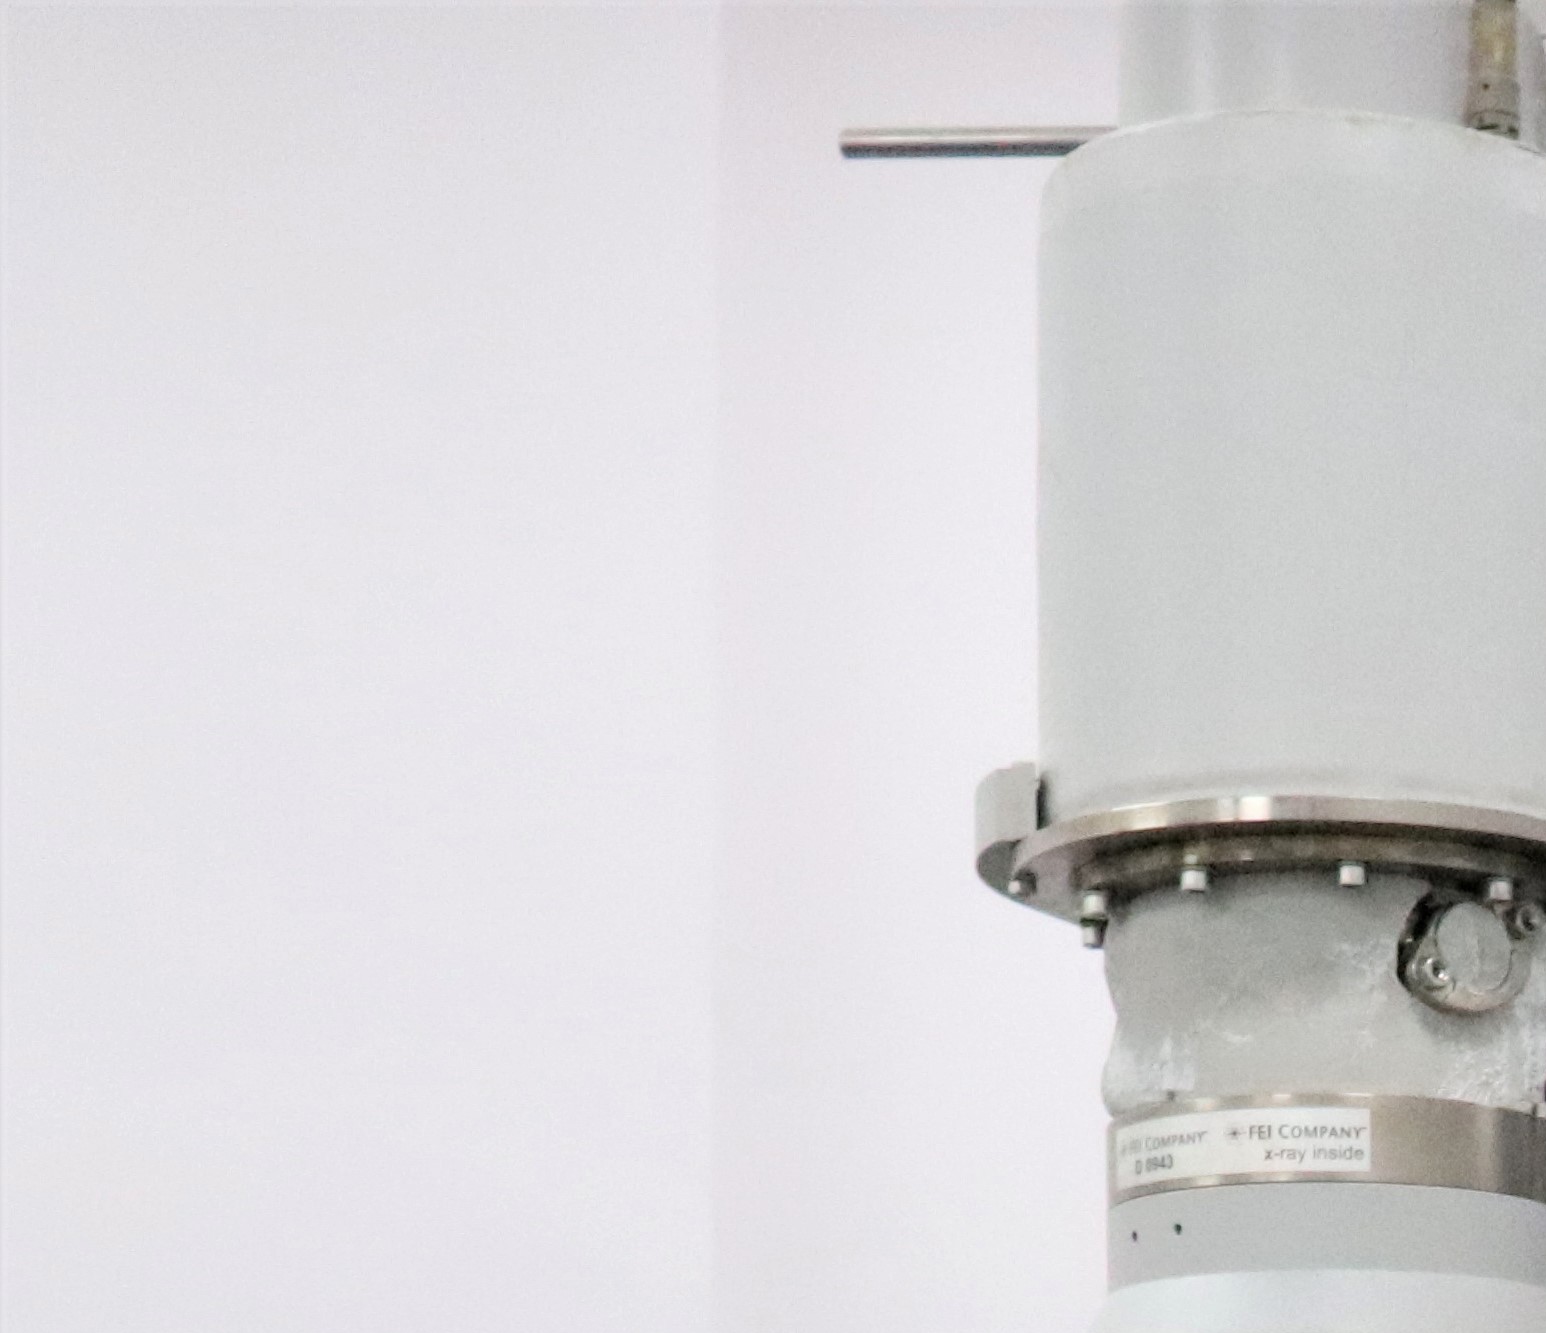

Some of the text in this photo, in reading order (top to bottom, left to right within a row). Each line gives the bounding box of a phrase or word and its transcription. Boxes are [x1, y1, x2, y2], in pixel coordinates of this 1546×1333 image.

[1145, 1131, 1206, 1151] COMPANY
[1249, 1124, 1363, 1140] FEI COMPANY
[1264, 1144, 1365, 1167] x-ray inside
